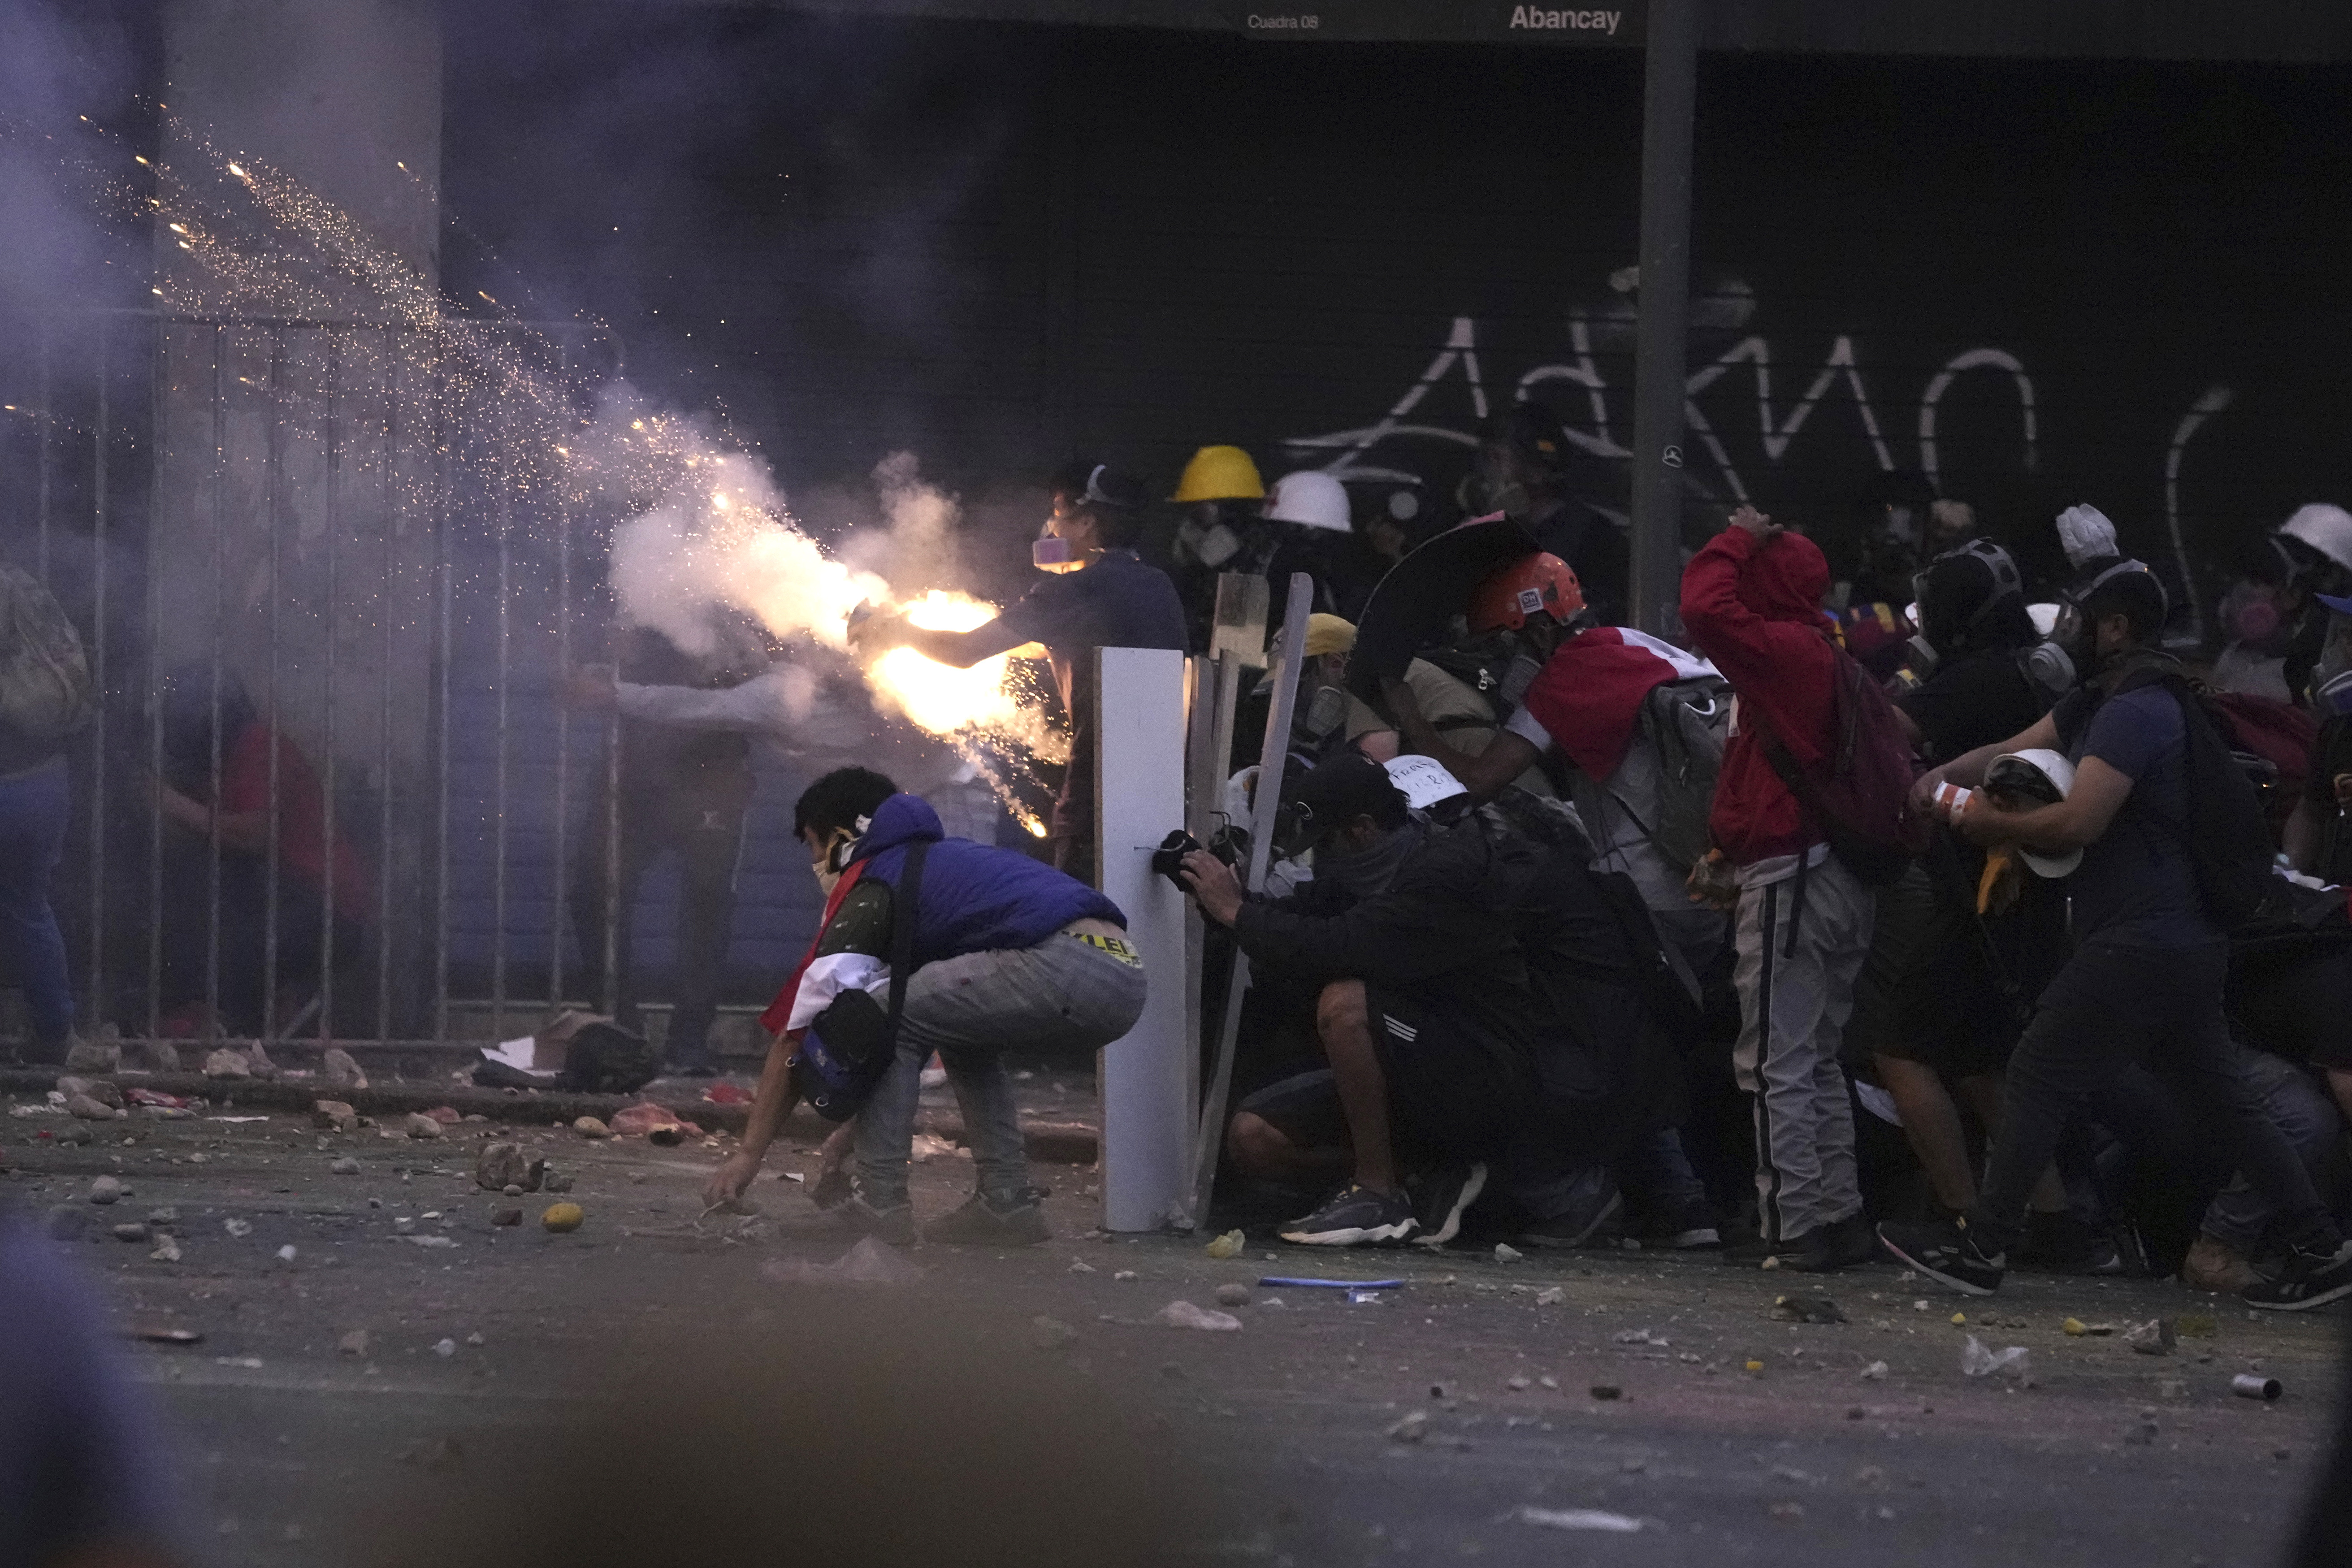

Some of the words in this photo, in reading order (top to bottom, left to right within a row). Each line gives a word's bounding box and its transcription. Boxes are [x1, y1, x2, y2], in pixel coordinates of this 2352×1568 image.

[1248, 14, 1298, 28] Cuadra
[1301, 15, 1319, 29] 08
[1509, 5, 1622, 35] Abancay
